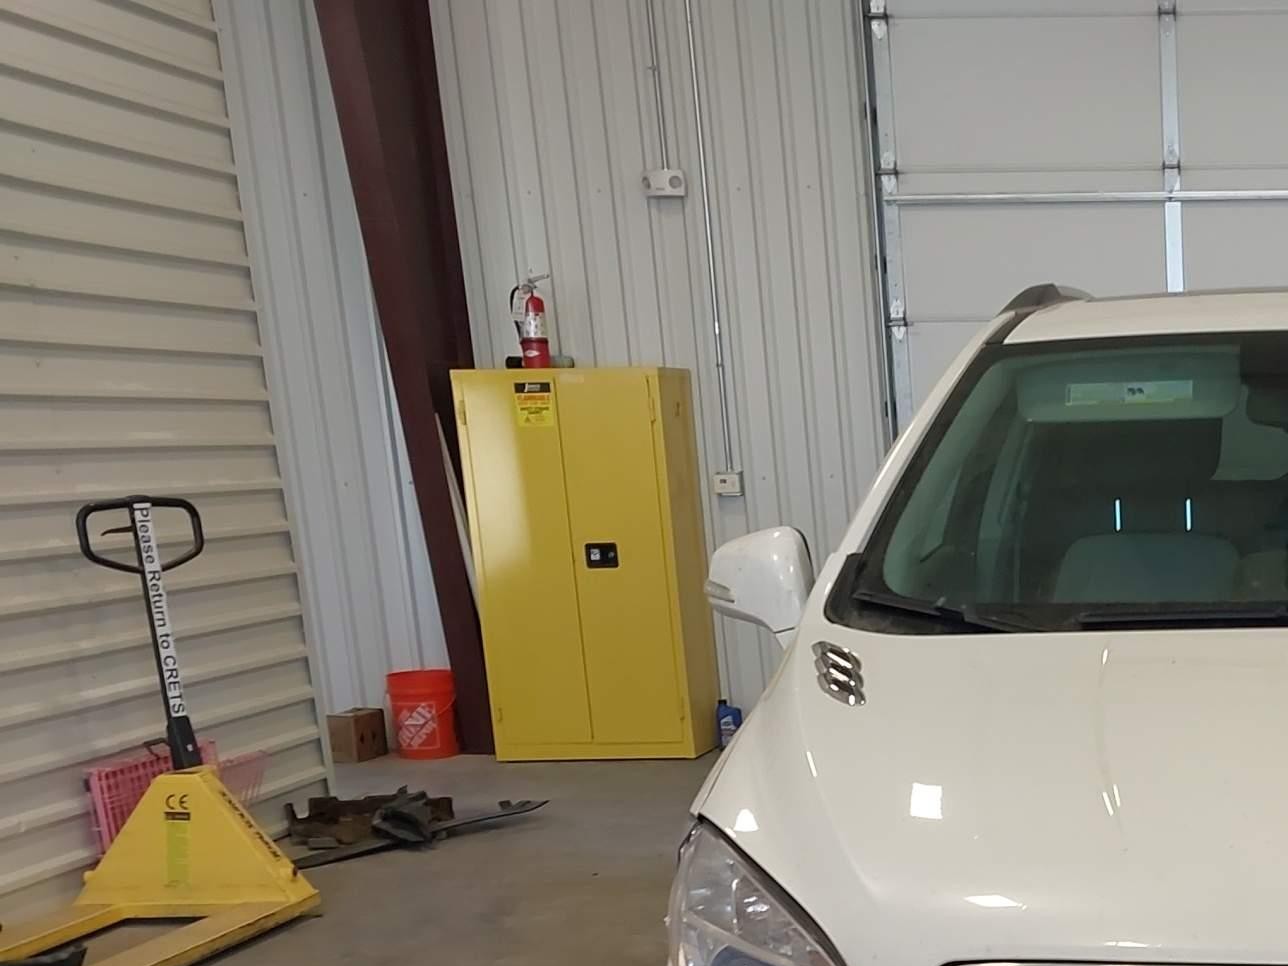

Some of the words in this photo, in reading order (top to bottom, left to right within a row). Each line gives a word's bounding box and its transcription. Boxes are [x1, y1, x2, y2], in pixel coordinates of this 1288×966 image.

[137, 507, 155, 565] Please
[147, 570, 168, 628] Return
[158, 633, 171, 650] to
[163, 655, 185, 714] CRETS
